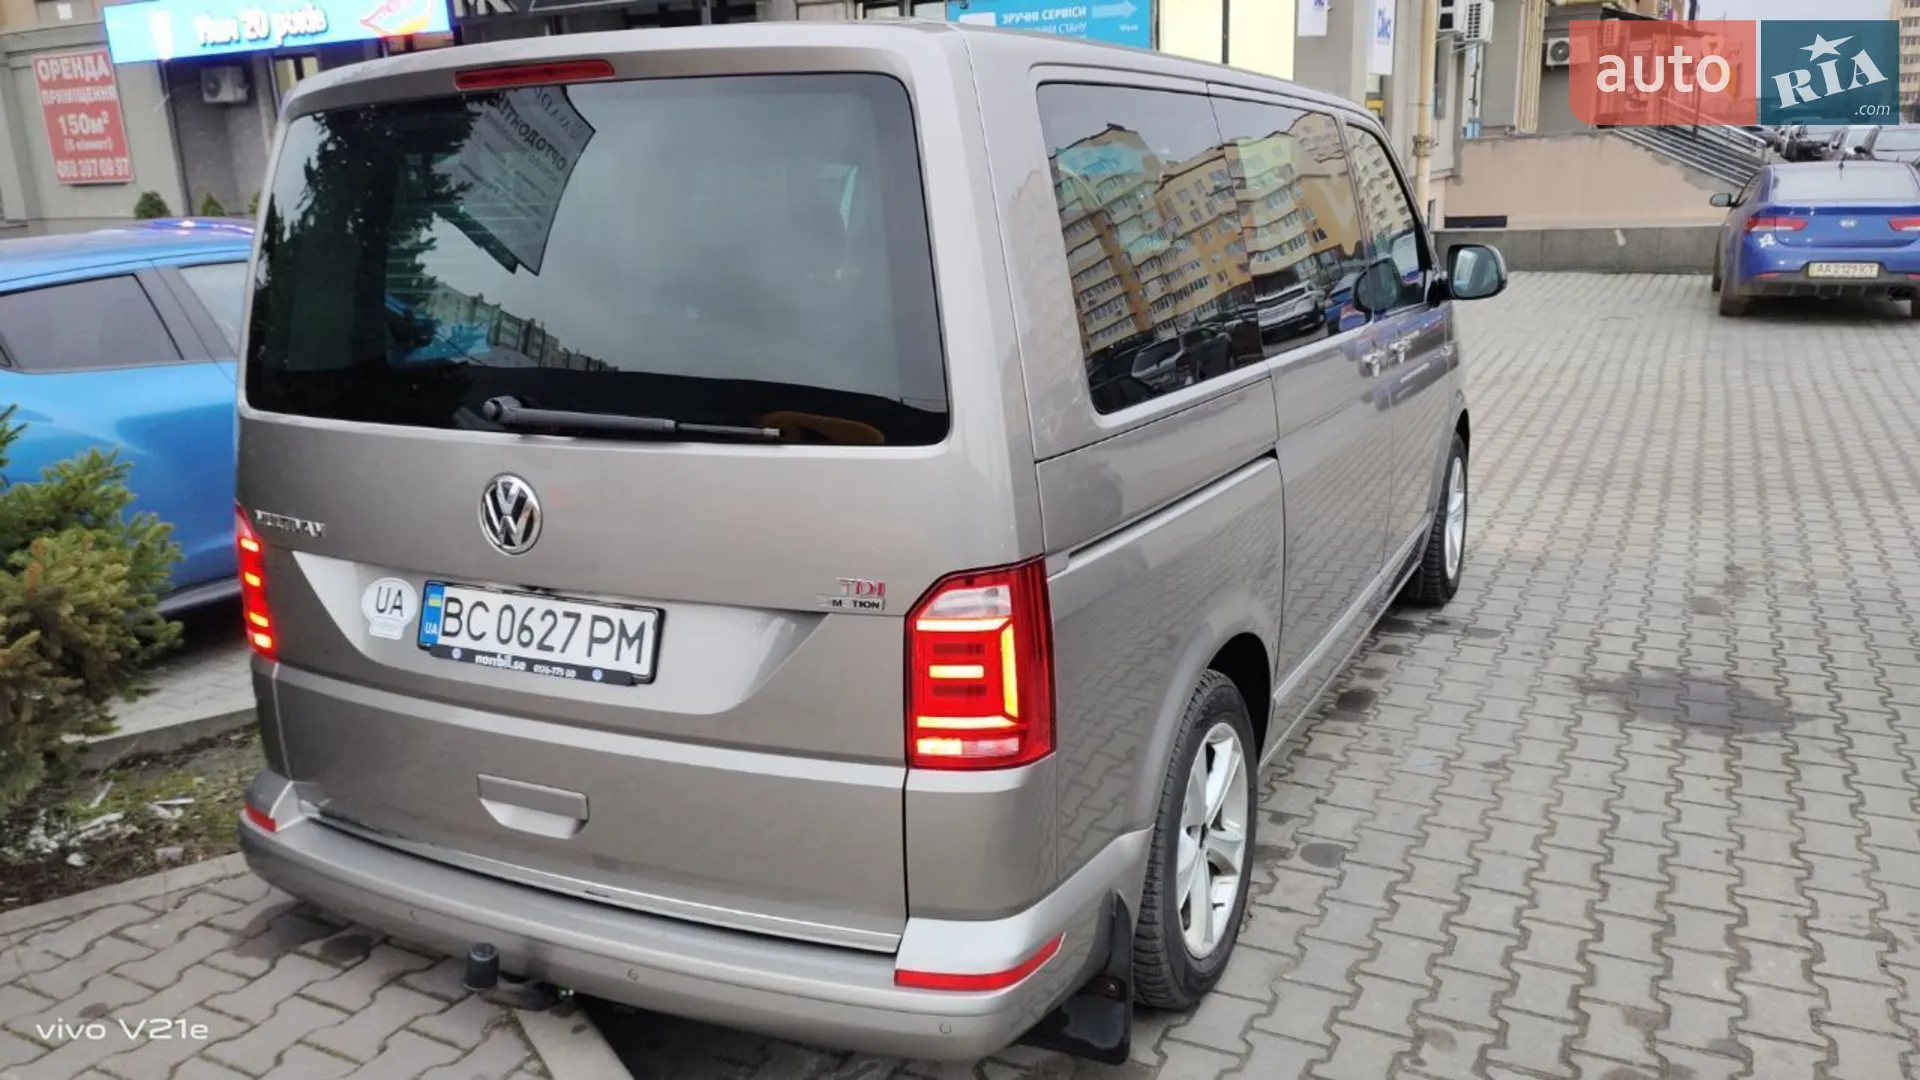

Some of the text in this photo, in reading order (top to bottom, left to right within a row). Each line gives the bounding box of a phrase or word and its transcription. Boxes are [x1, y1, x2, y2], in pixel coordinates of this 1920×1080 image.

[242, 9, 271, 41] 20
[1003, 6, 1087, 25] ЗРУЧНІ СЕРВІСИ
[37, 54, 110, 82] ОРЕНДА
[375, 586, 404, 617] UA
[424, 622, 439, 635] UA
[441, 597, 646, 665] BC 0627 PM
